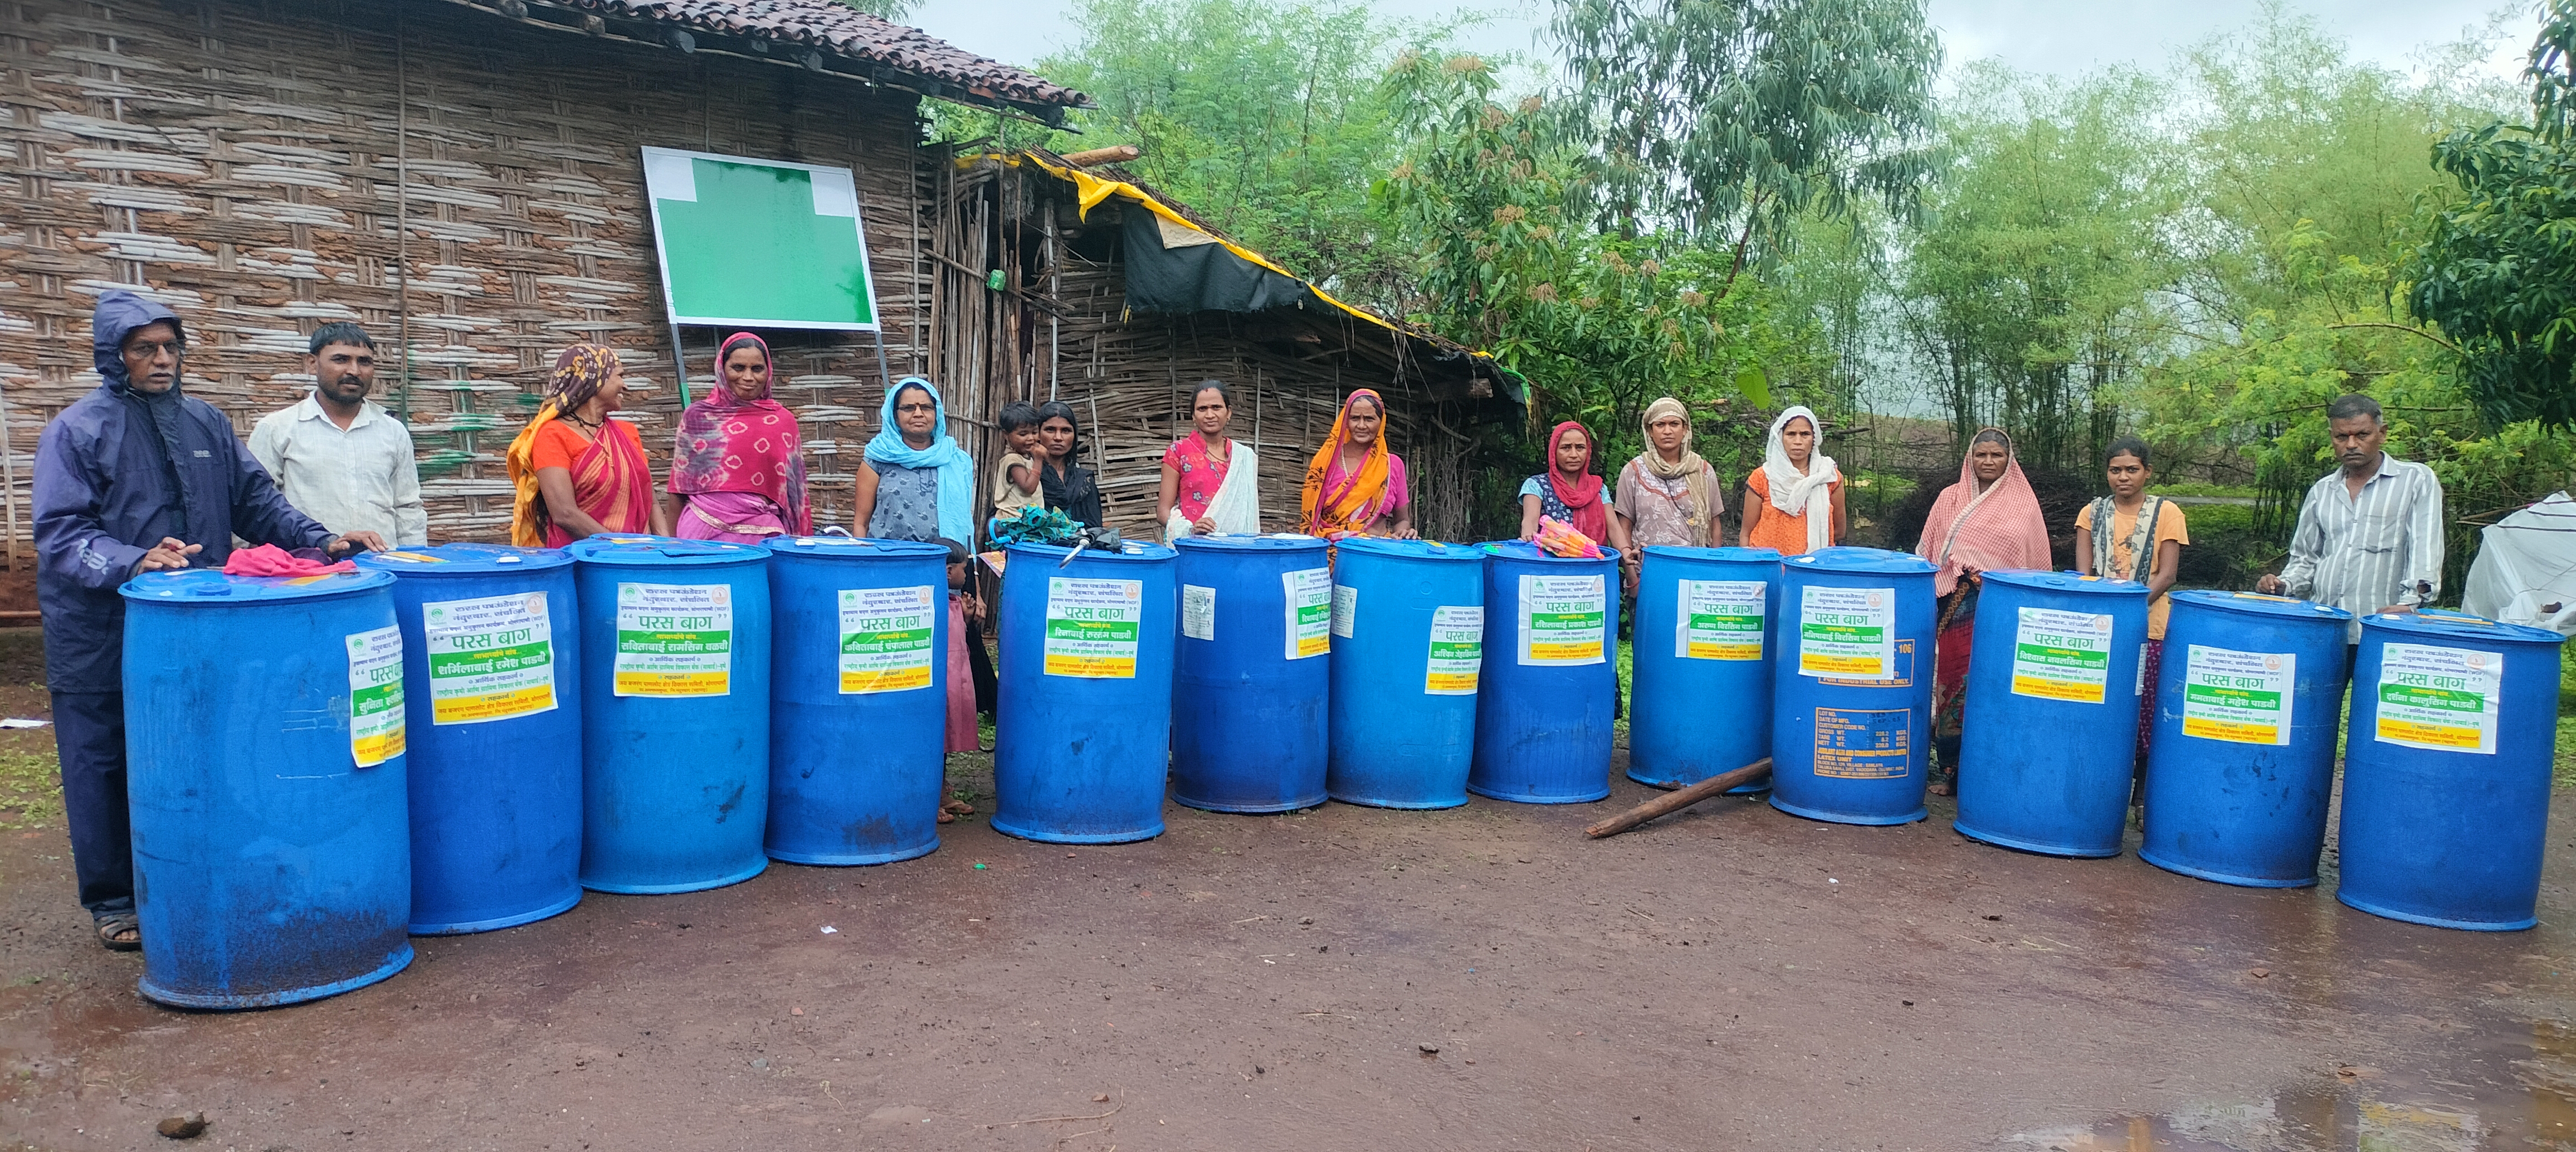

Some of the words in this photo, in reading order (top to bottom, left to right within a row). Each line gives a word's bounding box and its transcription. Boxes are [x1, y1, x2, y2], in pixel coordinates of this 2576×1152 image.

[1307, 592, 1323, 604] परस
[1064, 606, 1094, 619] परस
[1098, 608, 1125, 620] बाग
[1546, 602, 1571, 612] परस
[1574, 602, 1594, 611] बाग
[1705, 603, 1728, 613] परस
[1732, 605, 1753, 614] बाग
[639, 616, 675, 629] परस
[680, 616, 713, 629] बाग
[860, 618, 891, 630] परस
[895, 616, 920, 628] बाग
[1815, 613, 1839, 624] परस
[1843, 614, 1868, 625] बाग
[451, 632, 492, 650] परस
[497, 628, 531, 645] बाग
[1111, 630, 1131, 639] पाडवी
[1446, 631, 1464, 641] परस
[914, 637, 930, 647] पाडवी
[2034, 633, 2064, 646] परस
[2067, 637, 2095, 650] बाग
[1899, 644, 1911, 653] 106
[521, 651, 545, 666] पाडवी
[2084, 658, 2105, 667] पाडवी
[370, 666, 393, 683] परस
[2202, 673, 2231, 686] परस
[2236, 676, 2265, 689] बाग
[2398, 672, 2429, 686] परस
[2433, 675, 2466, 690] बाग
[359, 697, 383, 715] सुनिता
[2251, 700, 2276, 709] पाडवी
[2450, 699, 2476, 709] पाडवी
